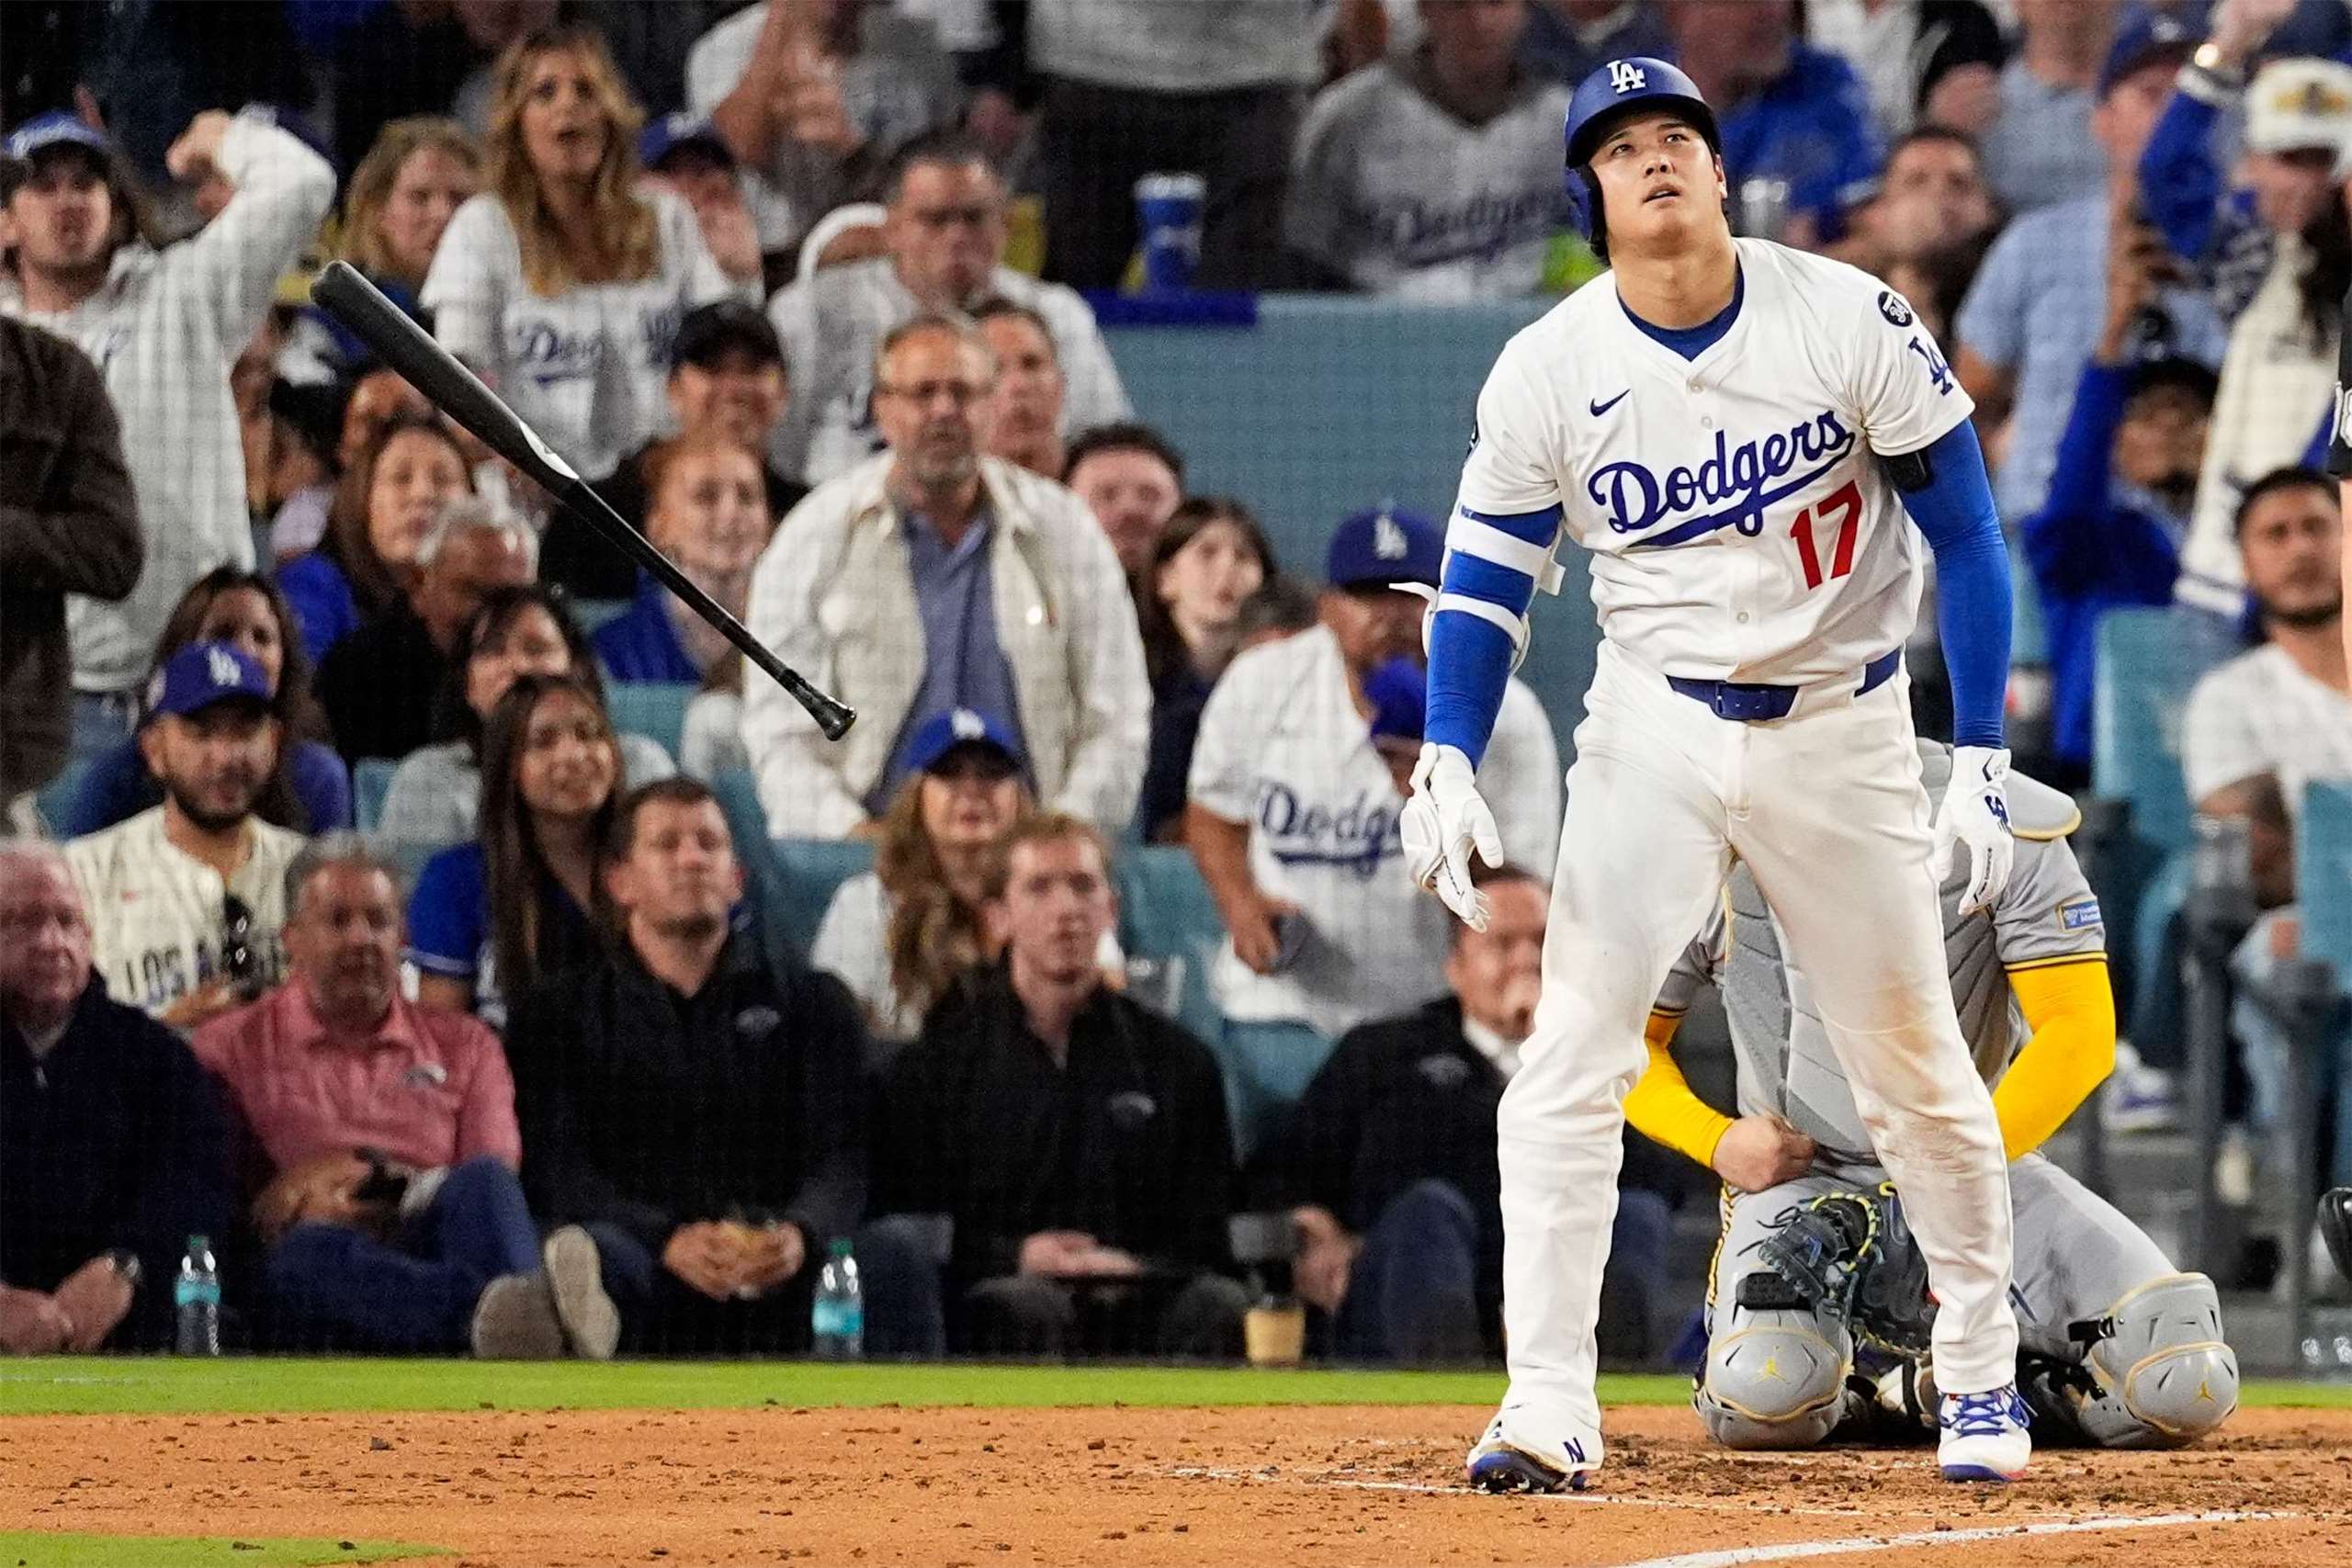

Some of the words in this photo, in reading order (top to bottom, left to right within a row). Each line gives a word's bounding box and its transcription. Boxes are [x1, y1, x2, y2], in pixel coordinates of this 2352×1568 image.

[1606, 60, 1645, 94] LA
[1908, 335, 1953, 396] LA
[1588, 411, 1856, 548] Dodgers
[1791, 479, 1863, 591] 17
[1257, 779, 1401, 882] Dodg
[1563, 1437, 1586, 1464] N
